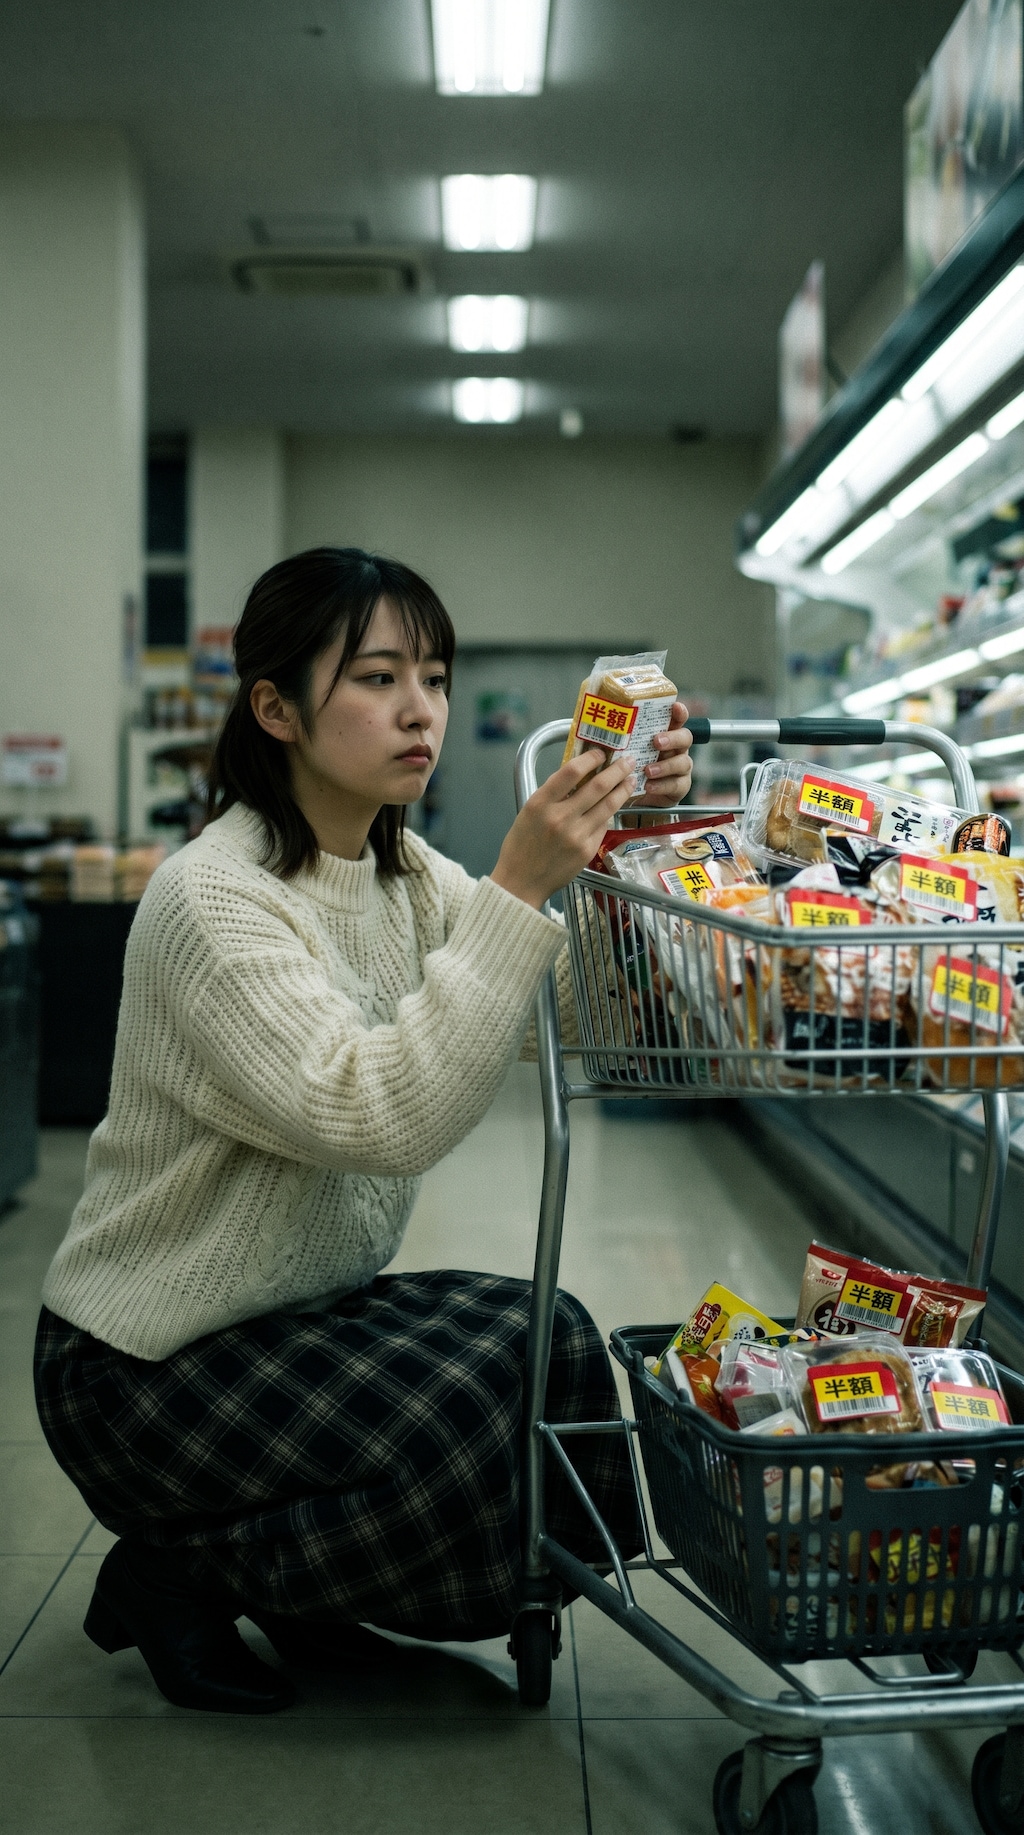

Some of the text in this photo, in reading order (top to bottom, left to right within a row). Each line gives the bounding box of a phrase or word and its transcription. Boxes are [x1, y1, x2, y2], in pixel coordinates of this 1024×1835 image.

[586, 702, 628, 731] 半額
[808, 788, 855, 814] 半額
[910, 870, 956, 898] 半額
[849, 1284, 895, 1312] 半額
[825, 1376, 875, 1399] 半額
[945, 1395, 991, 1417] 半額
